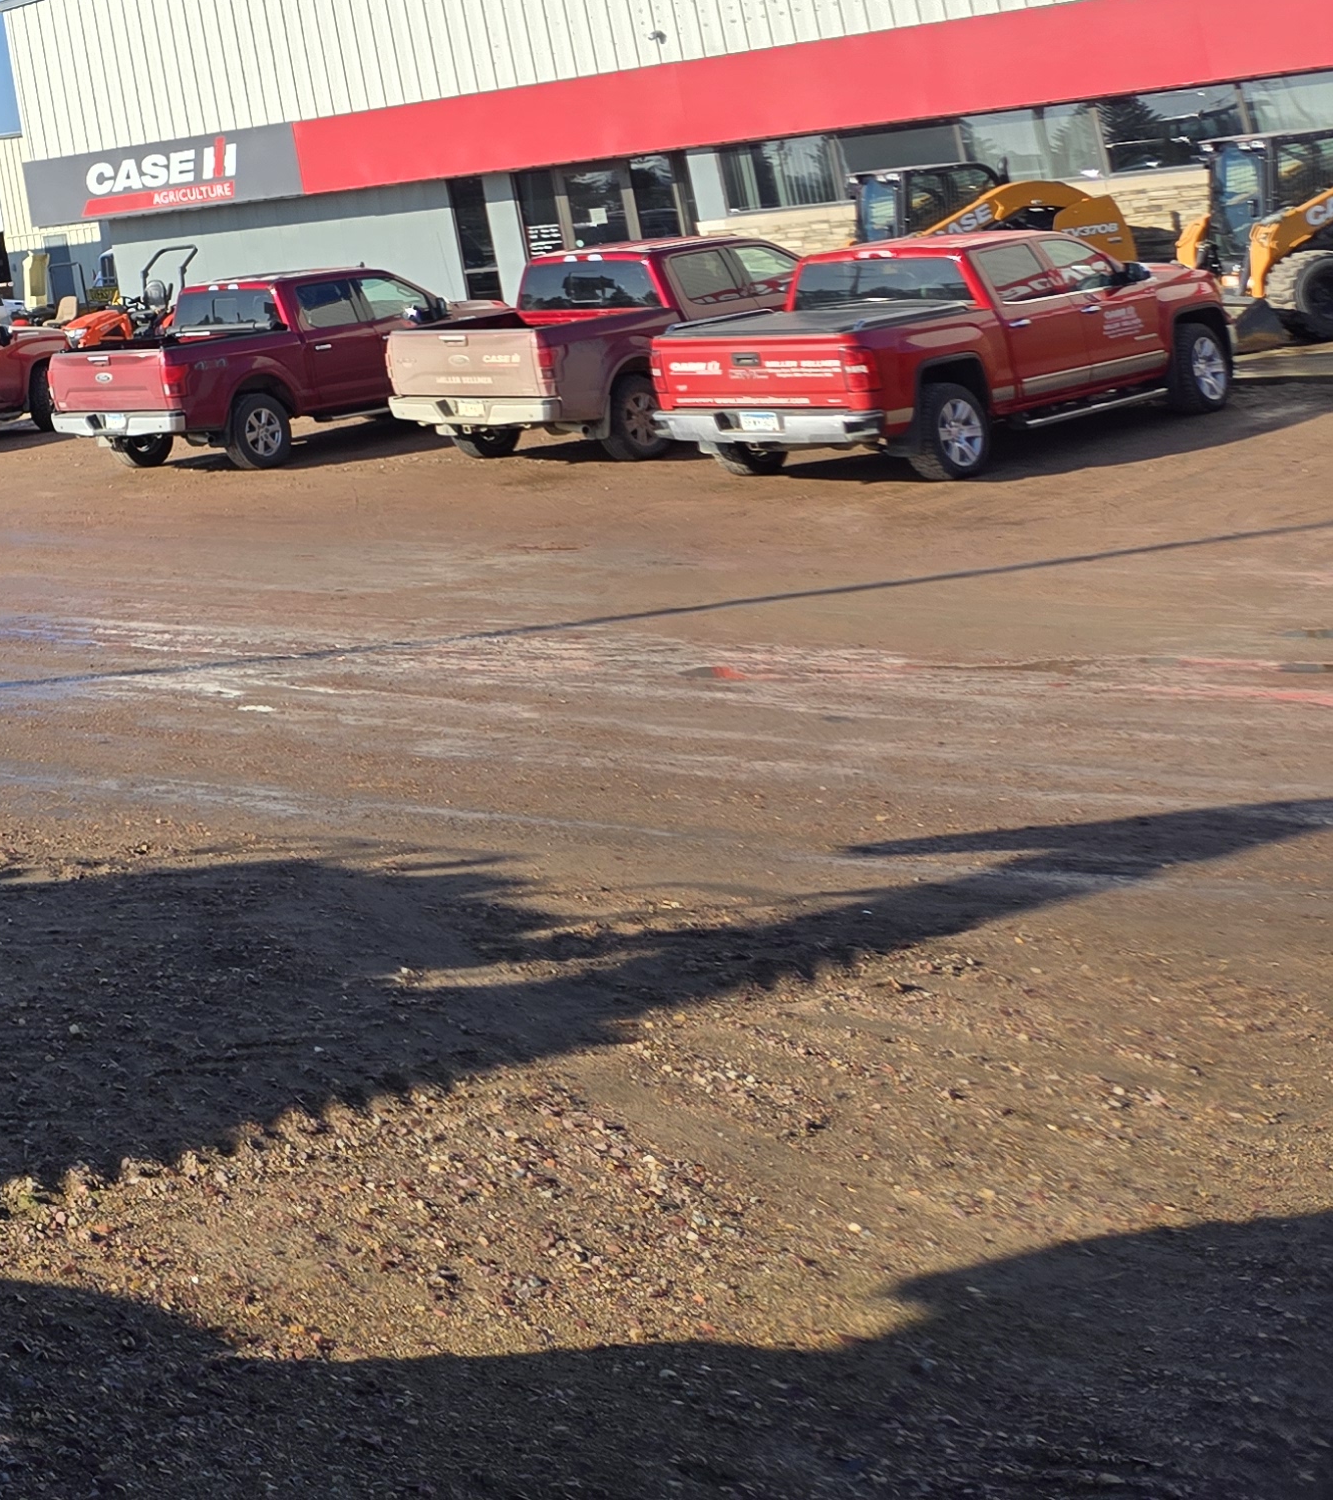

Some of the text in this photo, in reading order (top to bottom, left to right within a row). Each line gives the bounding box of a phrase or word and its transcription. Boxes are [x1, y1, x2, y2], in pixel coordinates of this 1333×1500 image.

[85, 148, 196, 196] CASE
[152, 182, 232, 205] AGRICULTURE
[935, 202, 994, 235] ASE
[482, 353, 511, 364] CASE
